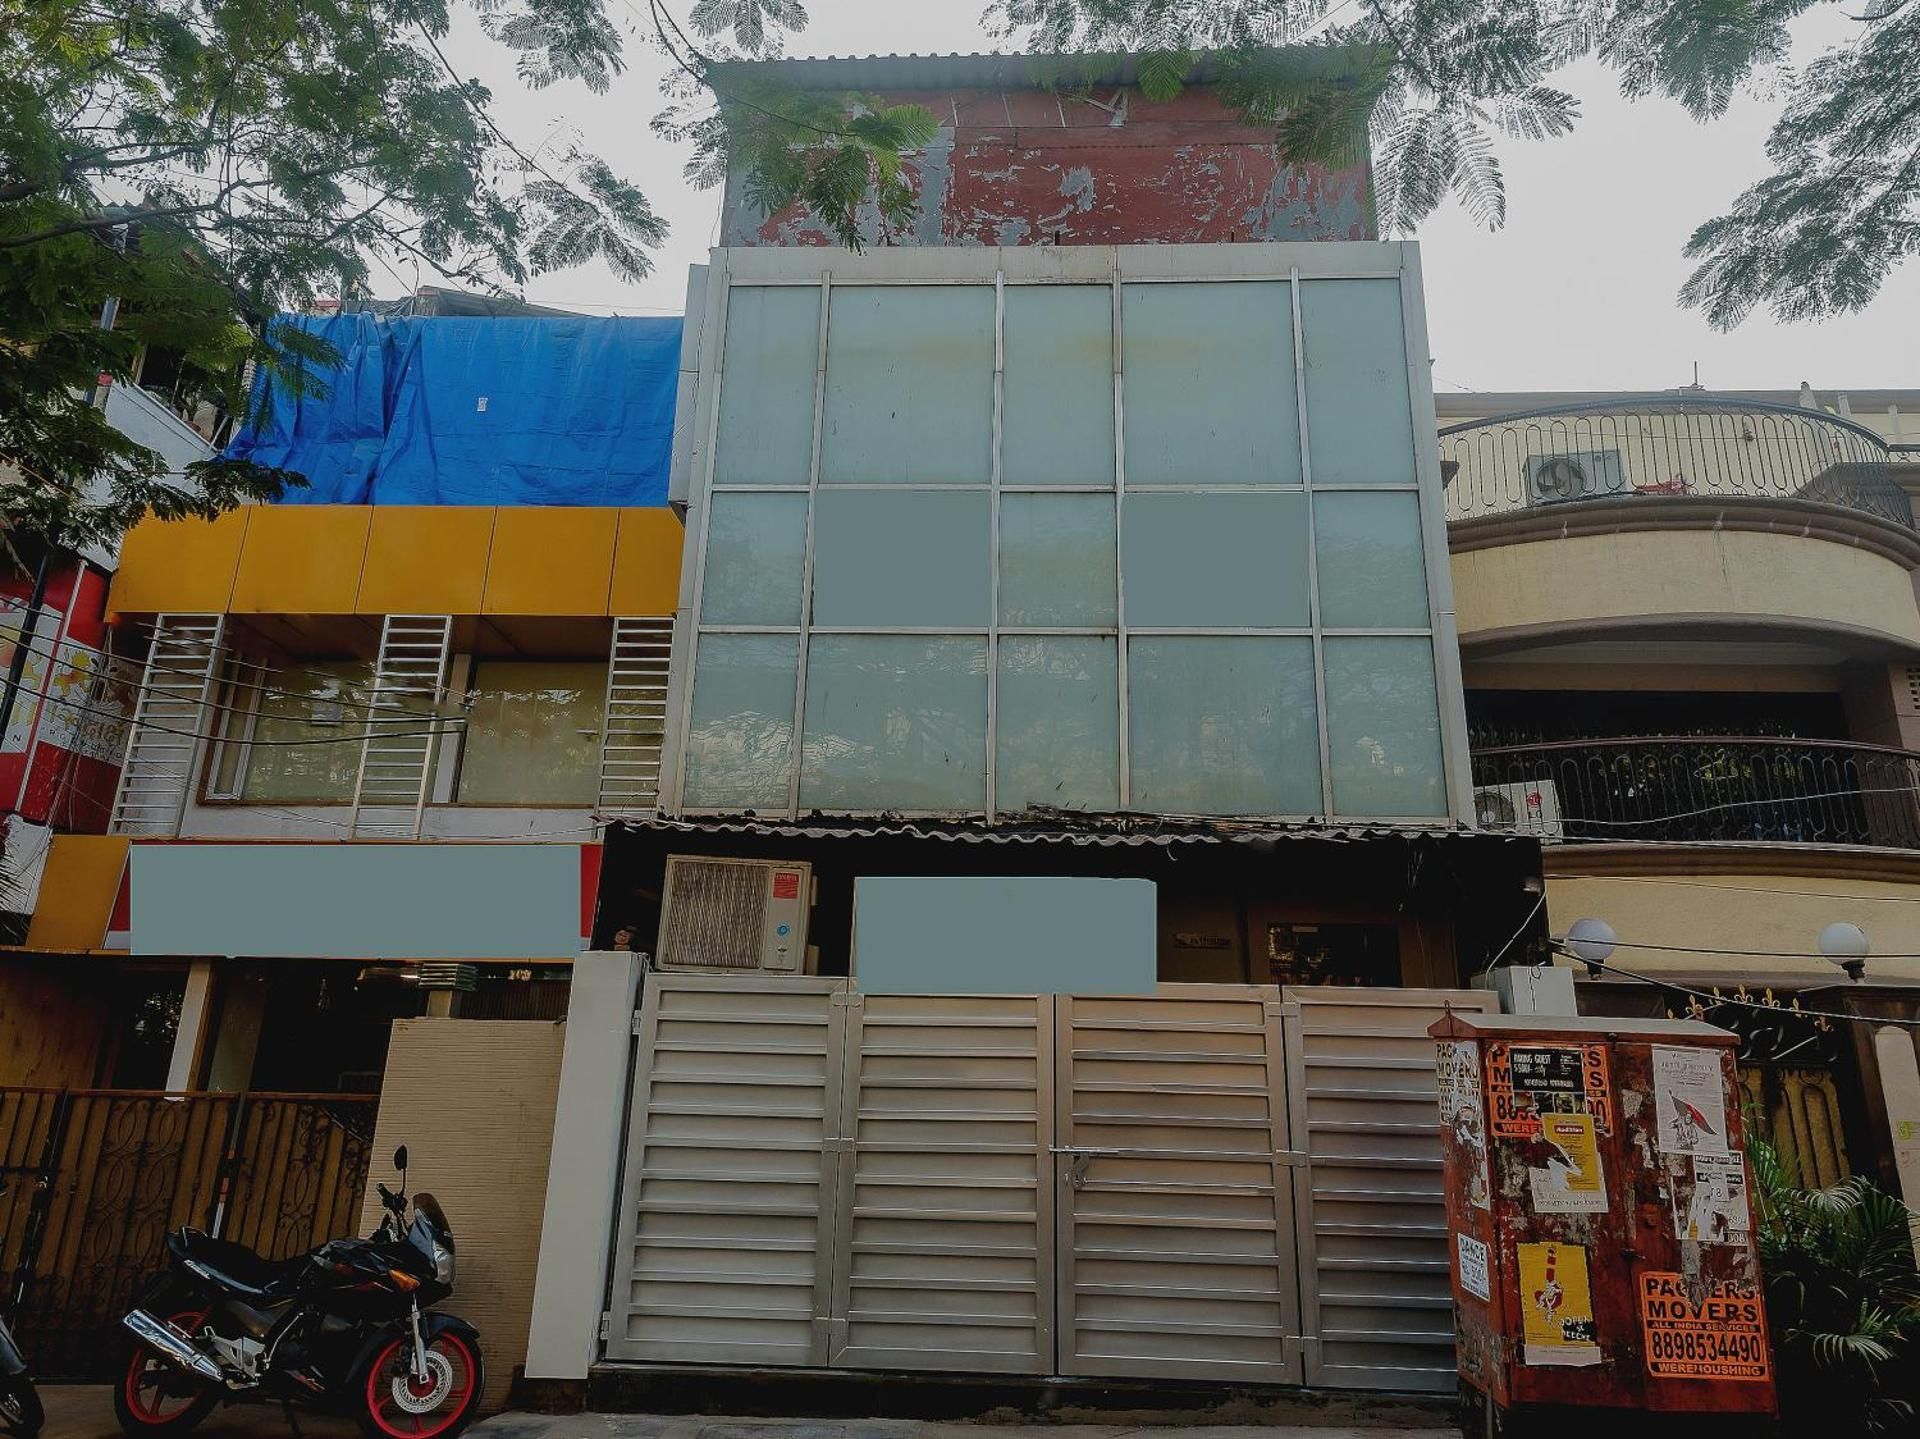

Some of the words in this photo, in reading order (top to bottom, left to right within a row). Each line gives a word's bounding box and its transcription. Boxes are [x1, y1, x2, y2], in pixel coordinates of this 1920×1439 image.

[1646, 1278, 1755, 1300] PACERS
[1648, 1300, 1758, 1322] MOVERS
[1652, 1321, 1672, 1329] ALL
[1674, 1322, 1703, 1330] INDIA
[1705, 1323, 1756, 1332] SERVICES
[1652, 1331, 1761, 1363] 8898534490
